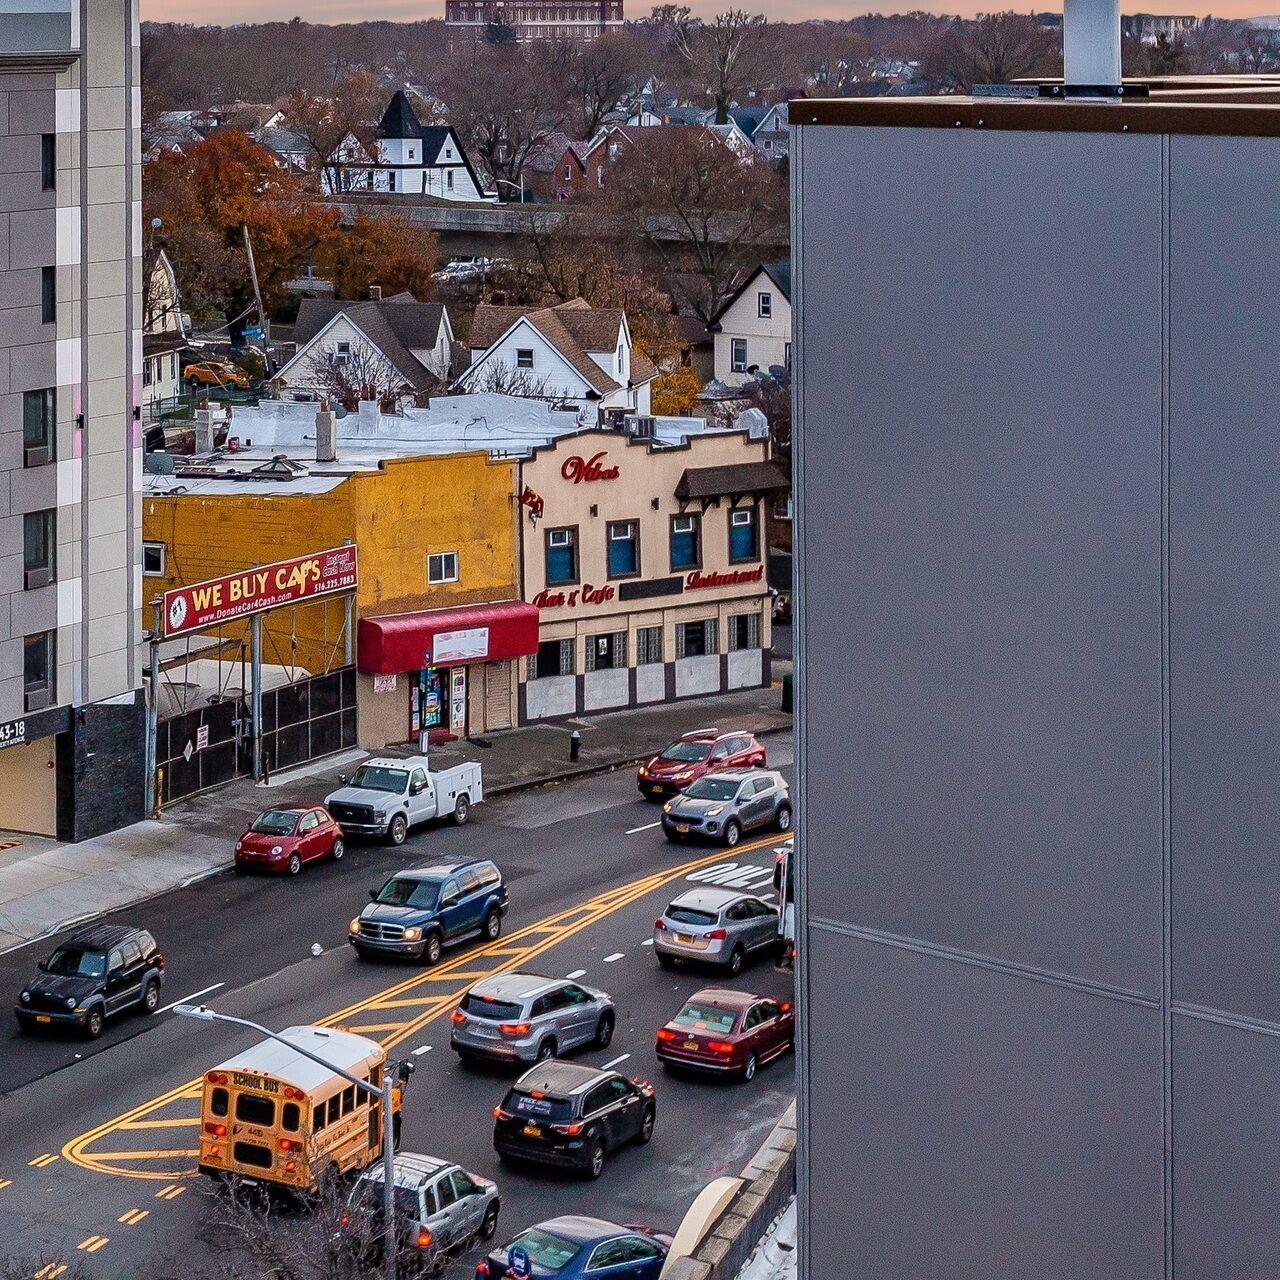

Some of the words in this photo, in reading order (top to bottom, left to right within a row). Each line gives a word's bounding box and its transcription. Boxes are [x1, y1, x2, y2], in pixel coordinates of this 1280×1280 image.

[192, 584, 223, 612] WE
[230, 571, 269, 602] BUY
[532, 588, 565, 608] Bar
[582, 583, 615, 605] Cafe
[684, 565, 764, 590] Restaurant
[233, 1072, 262, 1090] SCHOOL
[264, 1078, 278, 1093] BUS
